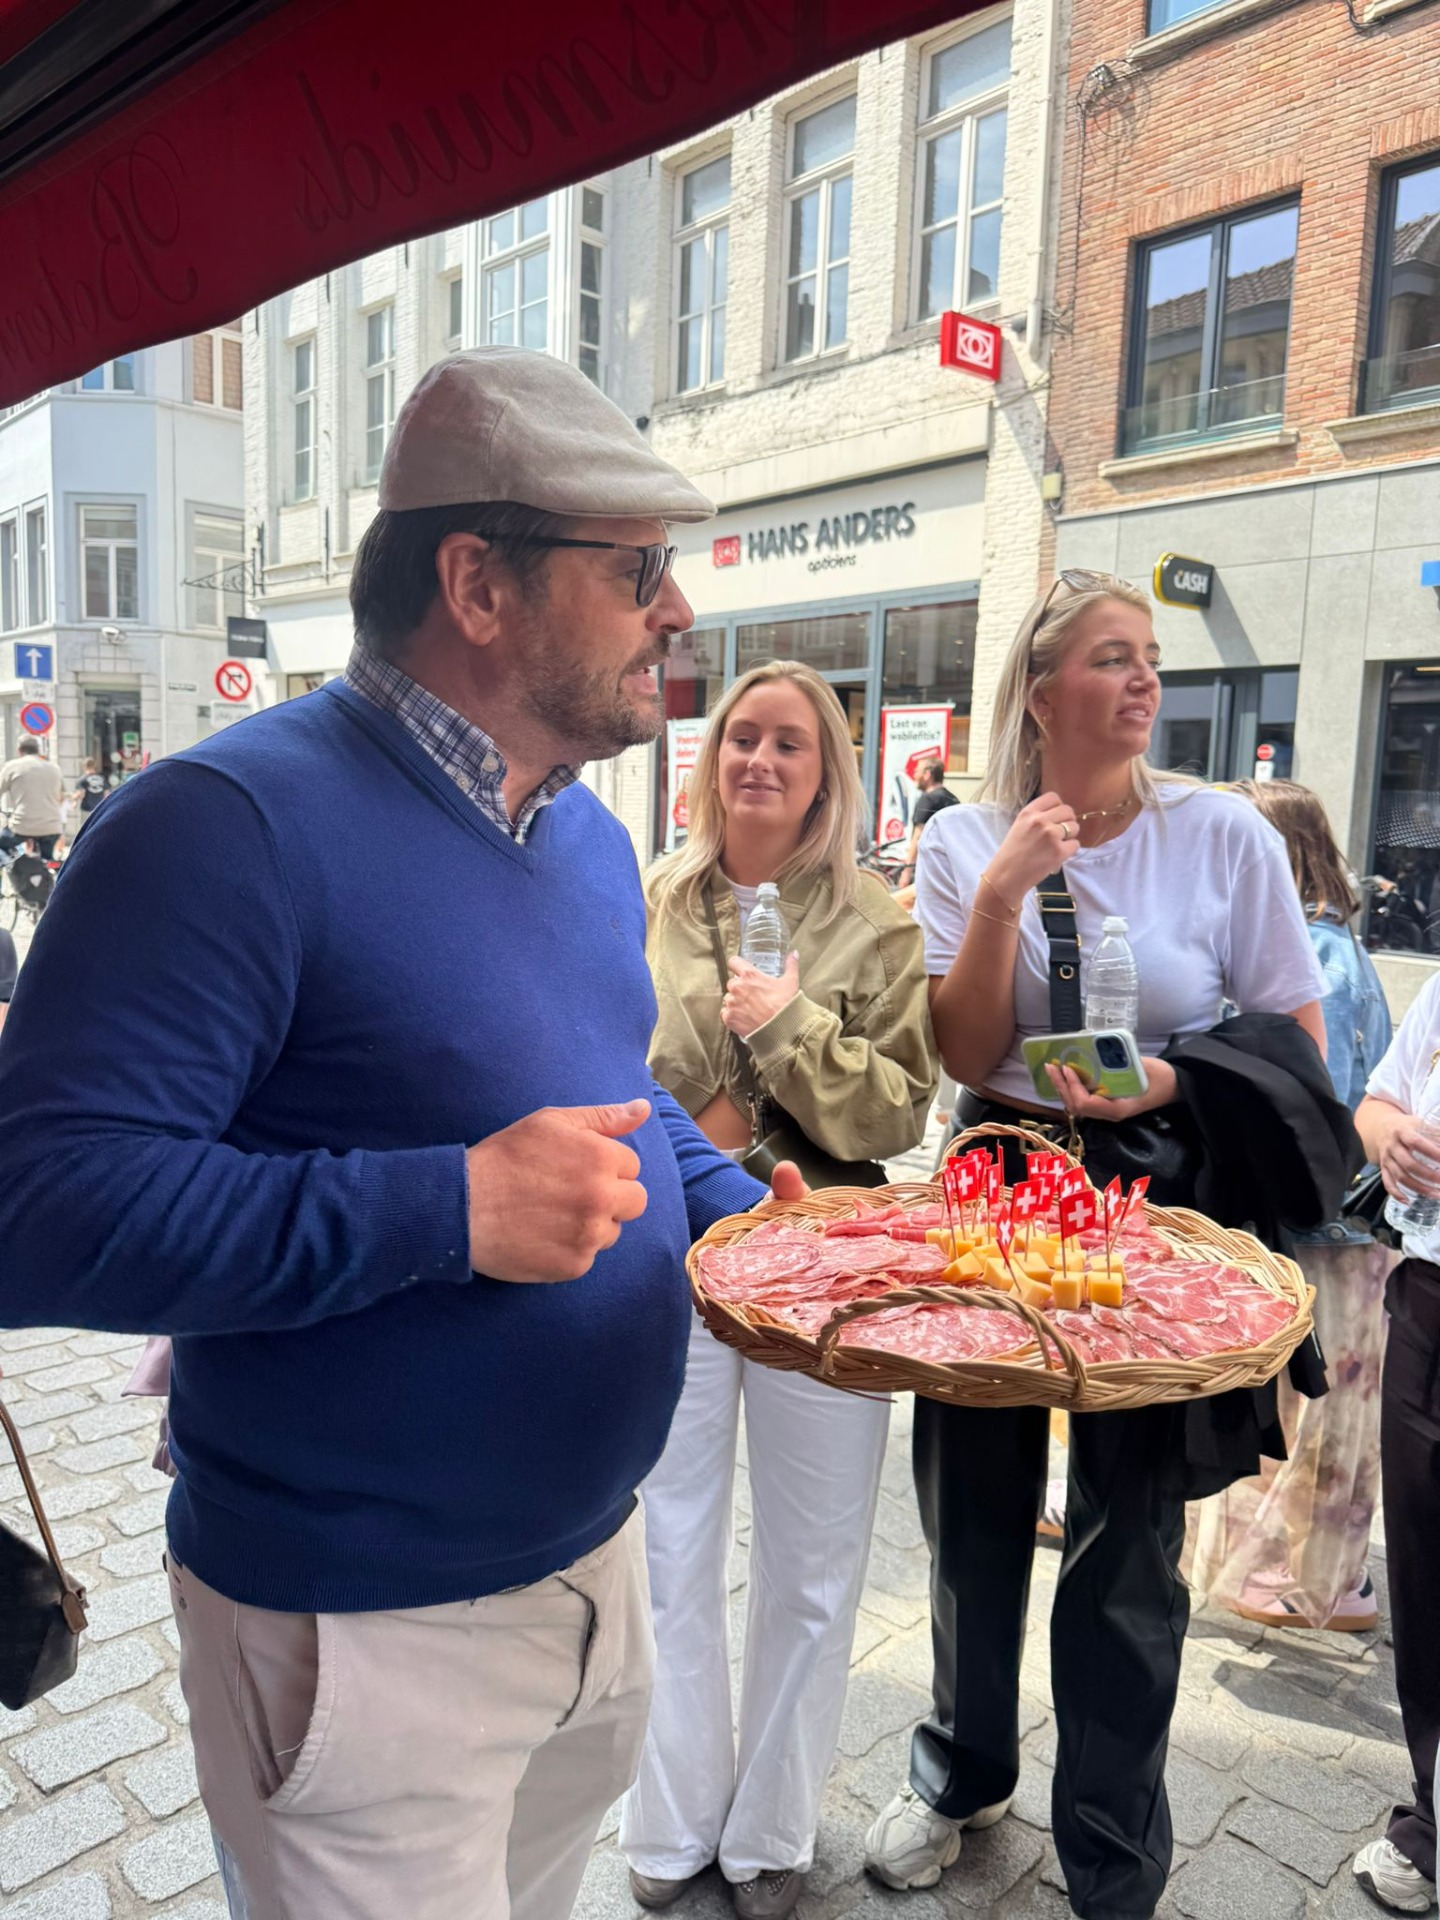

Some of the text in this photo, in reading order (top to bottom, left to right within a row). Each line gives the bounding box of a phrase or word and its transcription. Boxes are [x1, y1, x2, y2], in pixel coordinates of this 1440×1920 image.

[748, 501, 916, 563] HANS ANDERS
[807, 554, 857, 575] opticiens
[1173, 570, 1208, 595] CASH
[890, 719, 928, 729] Last van
